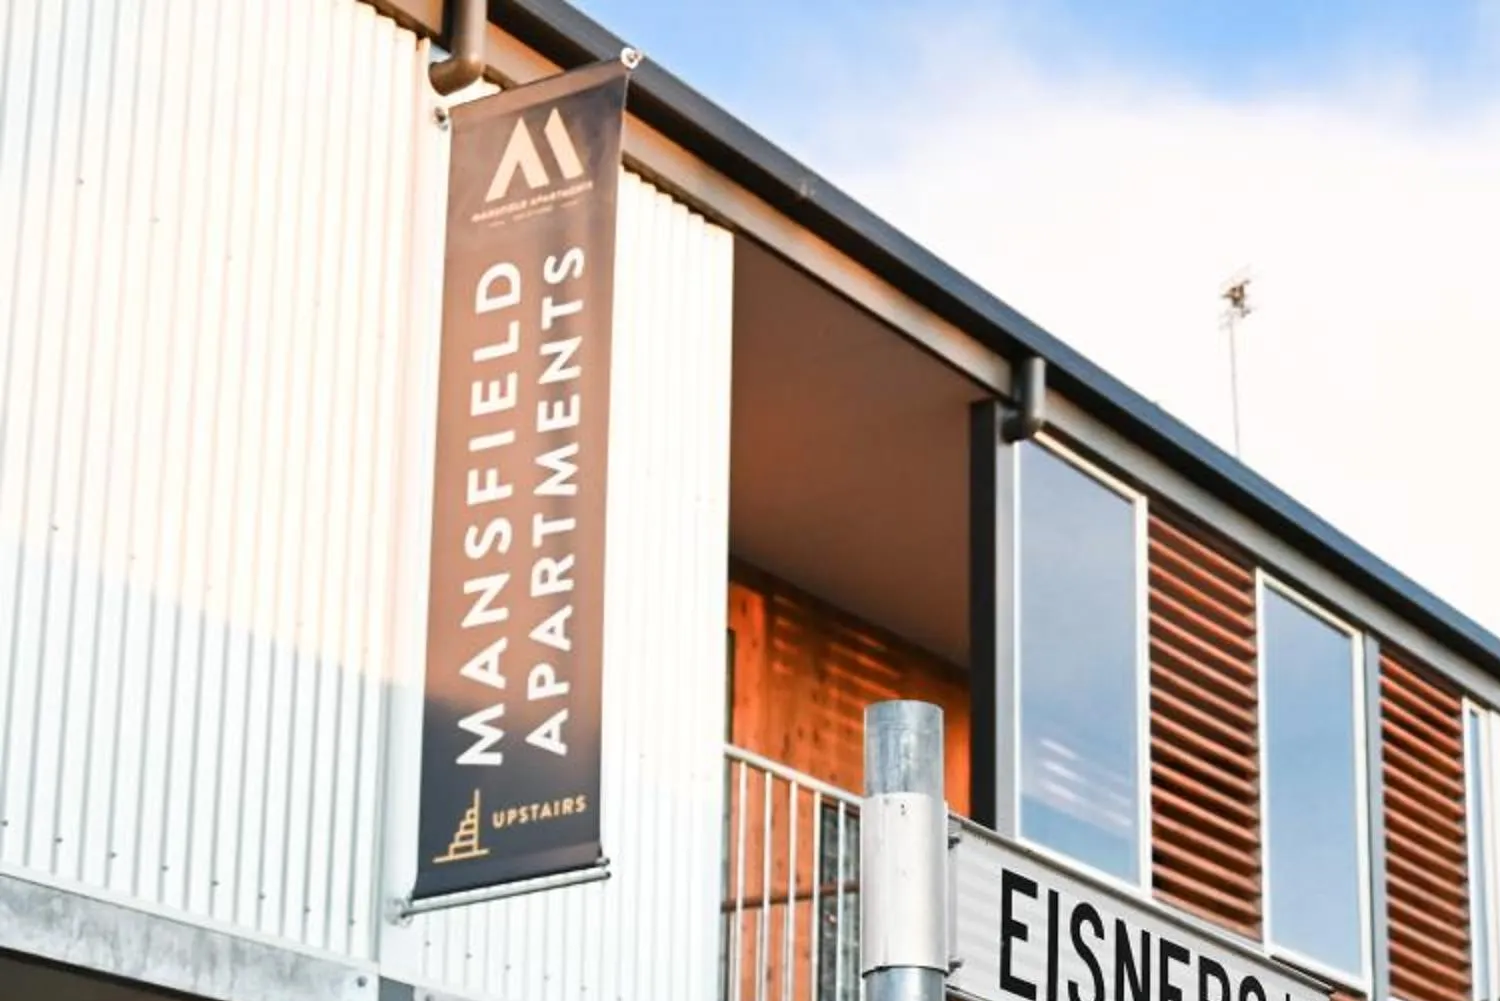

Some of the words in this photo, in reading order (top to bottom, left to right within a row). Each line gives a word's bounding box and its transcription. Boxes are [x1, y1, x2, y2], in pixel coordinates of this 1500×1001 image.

[456, 262, 521, 765] MANSFIELD
[525, 246, 585, 756] APARTMENTS
[492, 795, 587, 828] UPSTAIRS
